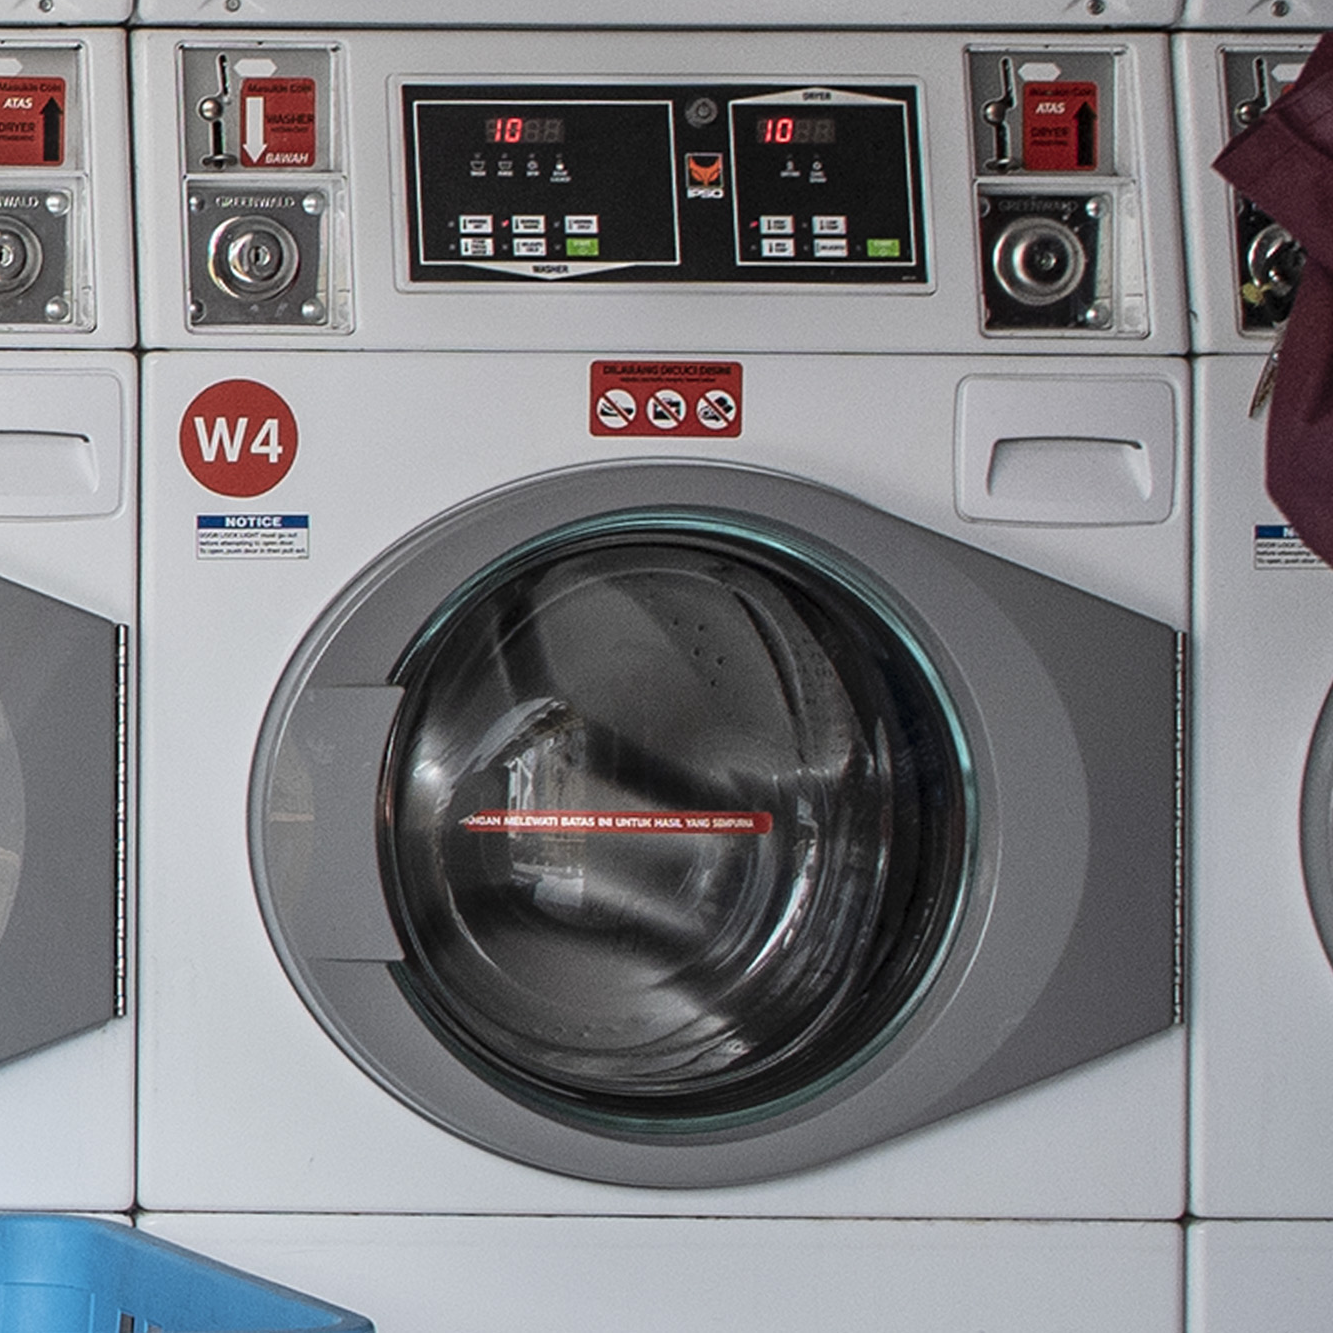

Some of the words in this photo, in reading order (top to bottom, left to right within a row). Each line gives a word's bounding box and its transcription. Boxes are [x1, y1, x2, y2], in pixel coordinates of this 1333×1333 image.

[2, 96, 35, 110] ATAS
[493, 117, 523, 143] 10
[762, 118, 794, 143] 10
[532, 263, 570, 274] WASHER
[192, 416, 284, 464] W4
[224, 516, 283, 528] NOTICE
